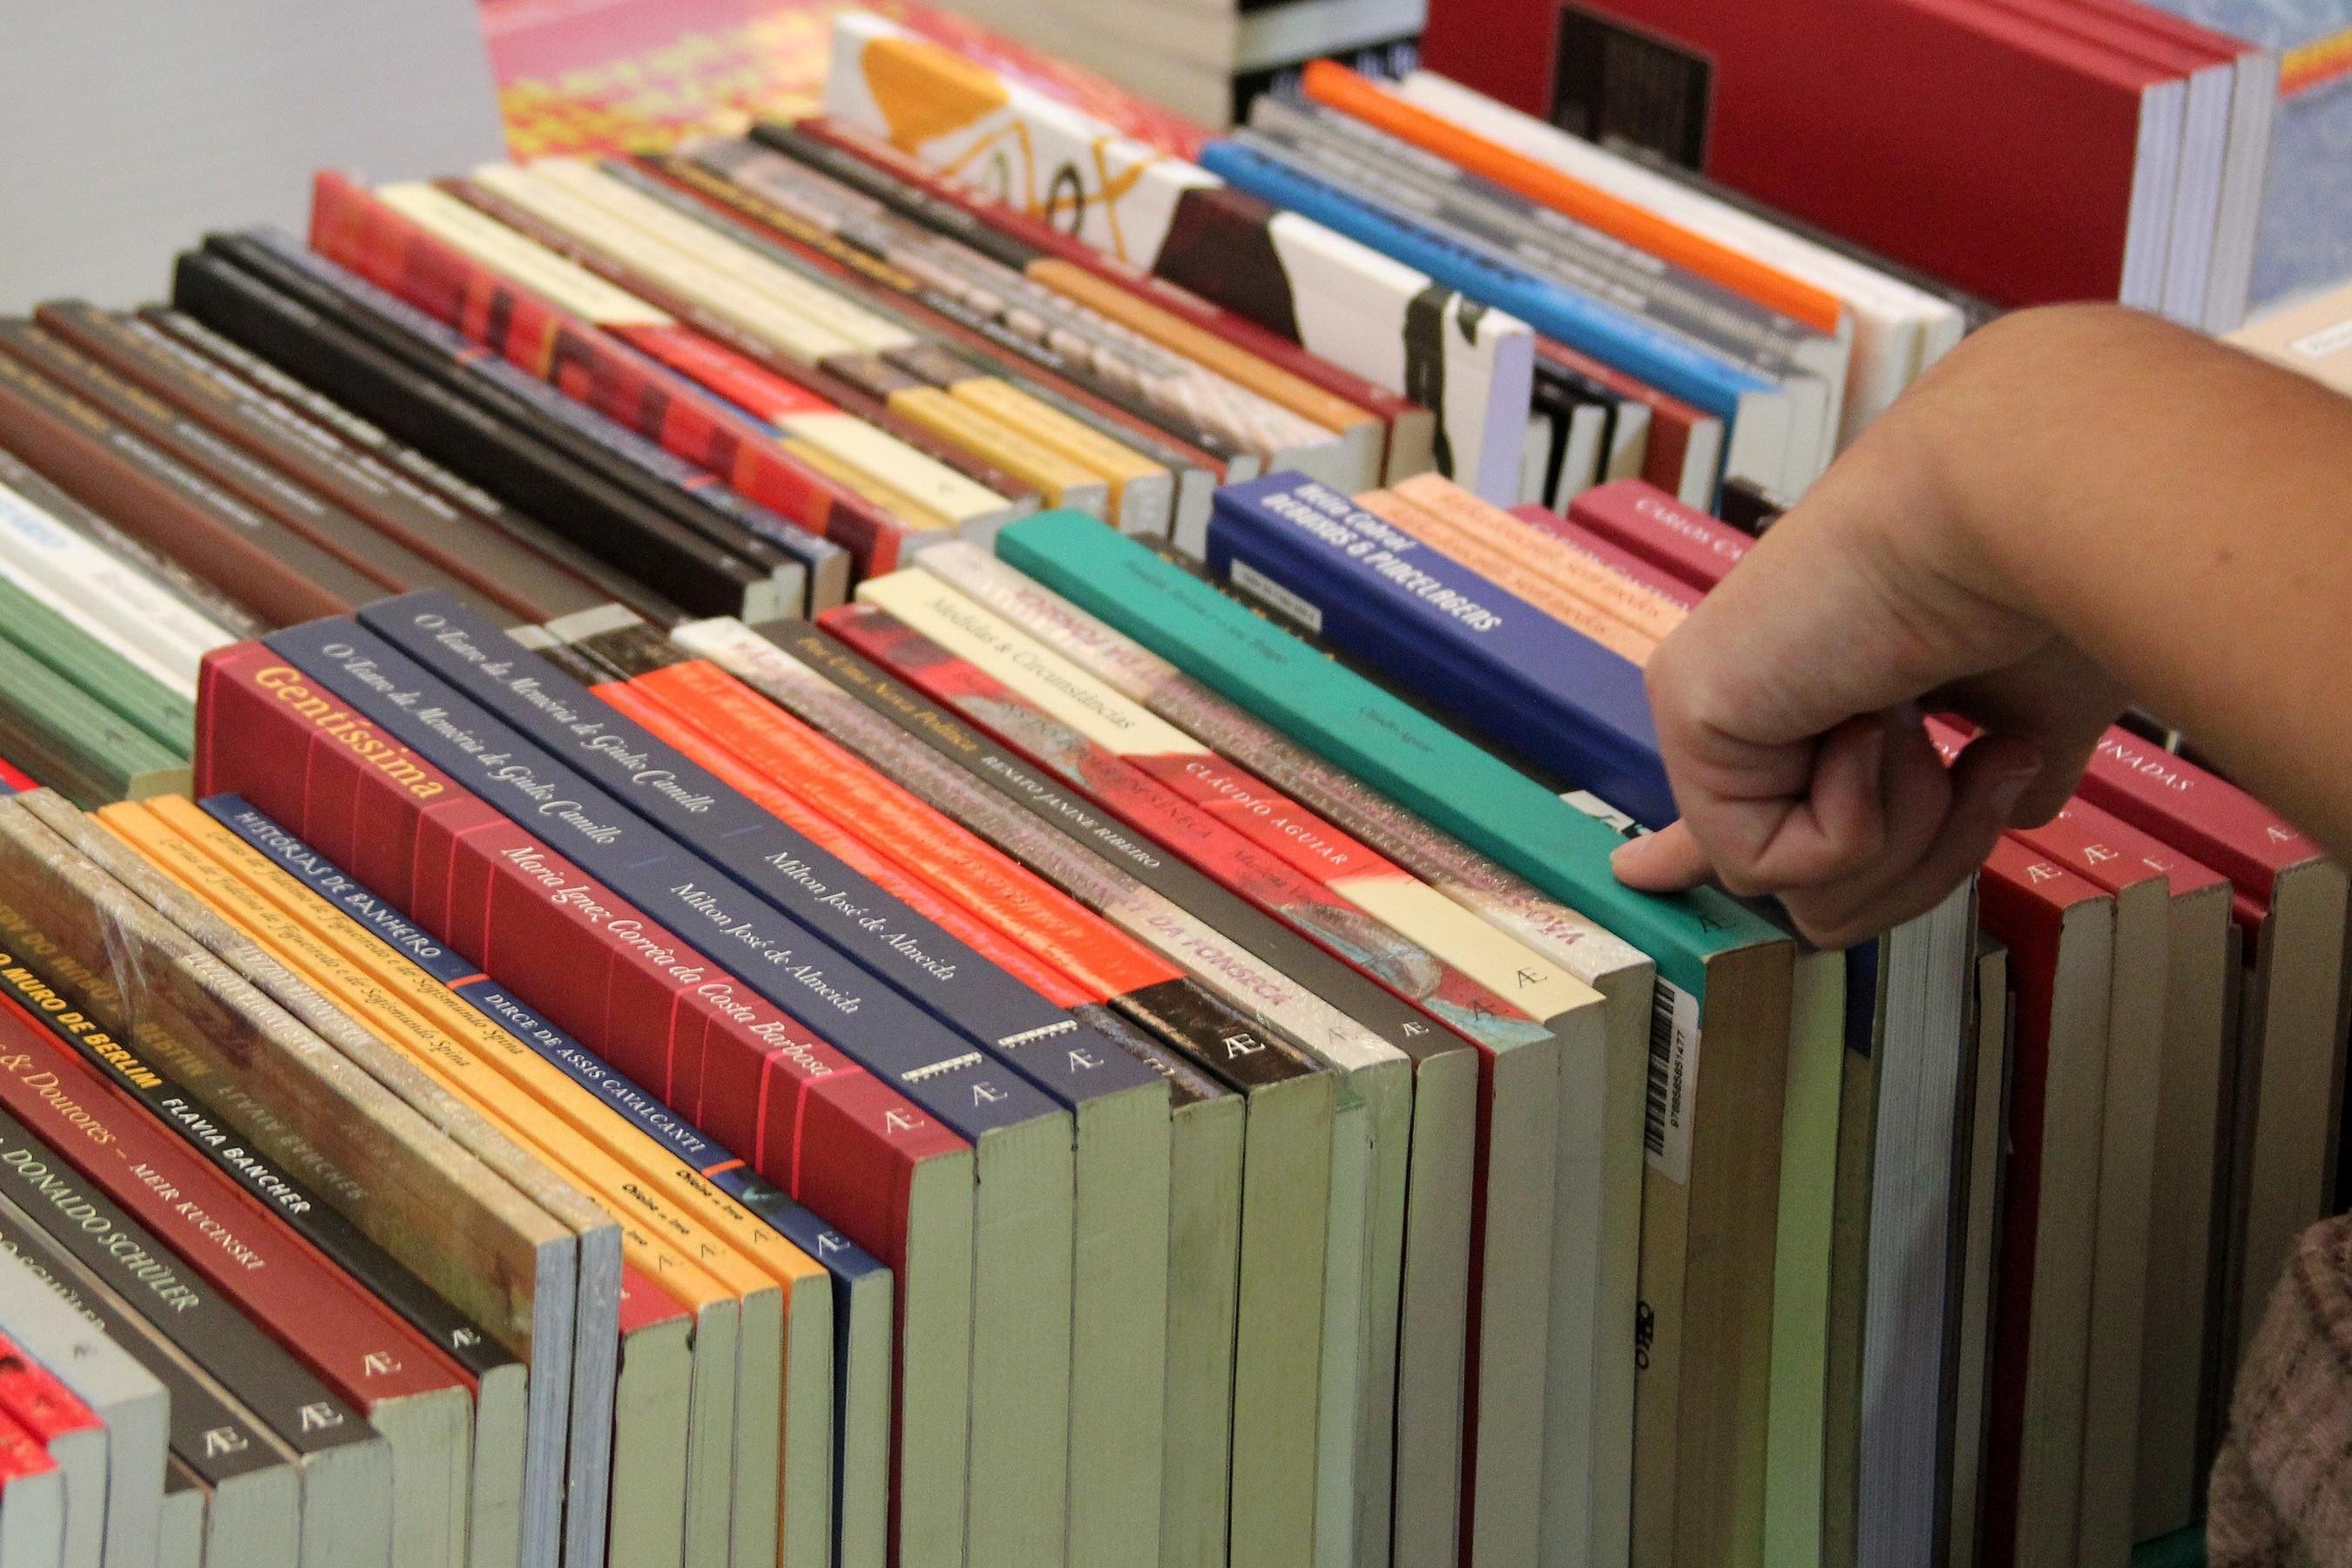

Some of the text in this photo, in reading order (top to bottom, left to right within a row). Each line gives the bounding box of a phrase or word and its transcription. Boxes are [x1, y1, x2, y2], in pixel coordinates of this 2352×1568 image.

[322, 643, 355, 658] O
[538, 800, 622, 844] Camillo
[415, 613, 447, 630] O
[633, 769, 716, 814] Camillo
[234, 811, 441, 959] HISTÓRIAS DE BANHEIRO
[981, 755, 1160, 868] RENATO JANINE RIBEIRO
[1186, 760, 1349, 866] CLÁUDIO AGUIAR
[502, 846, 835, 1078] Maria Ignez Corrêa da Costa Barbosa
[670, 882, 862, 1016] Milton José de Almeida
[764, 850, 957, 983] Milton José de Almeida
[1, 966, 67, 1011] MURO
[57, 1010, 97, 1035] DE
[83, 1033, 163, 1089] BERLIM
[162, 1098, 226, 1146] FLAVIA
[222, 1147, 311, 1214] BANCHER
[429, 1036, 470, 1067] Spina
[483, 1024, 524, 1055] Spina
[484, 993, 706, 1153] DIRCE DE ASSIS CAVALCANTI
[0, 1054, 33, 1071] &
[21, 1071, 116, 1146] Doutores
[129, 1163, 180, 1202] MEIR
[176, 1200, 266, 1270] KUCINSKI
[2, 1148, 112, 1233] DONALDO
[98, 1232, 199, 1313] SCHÜLER
